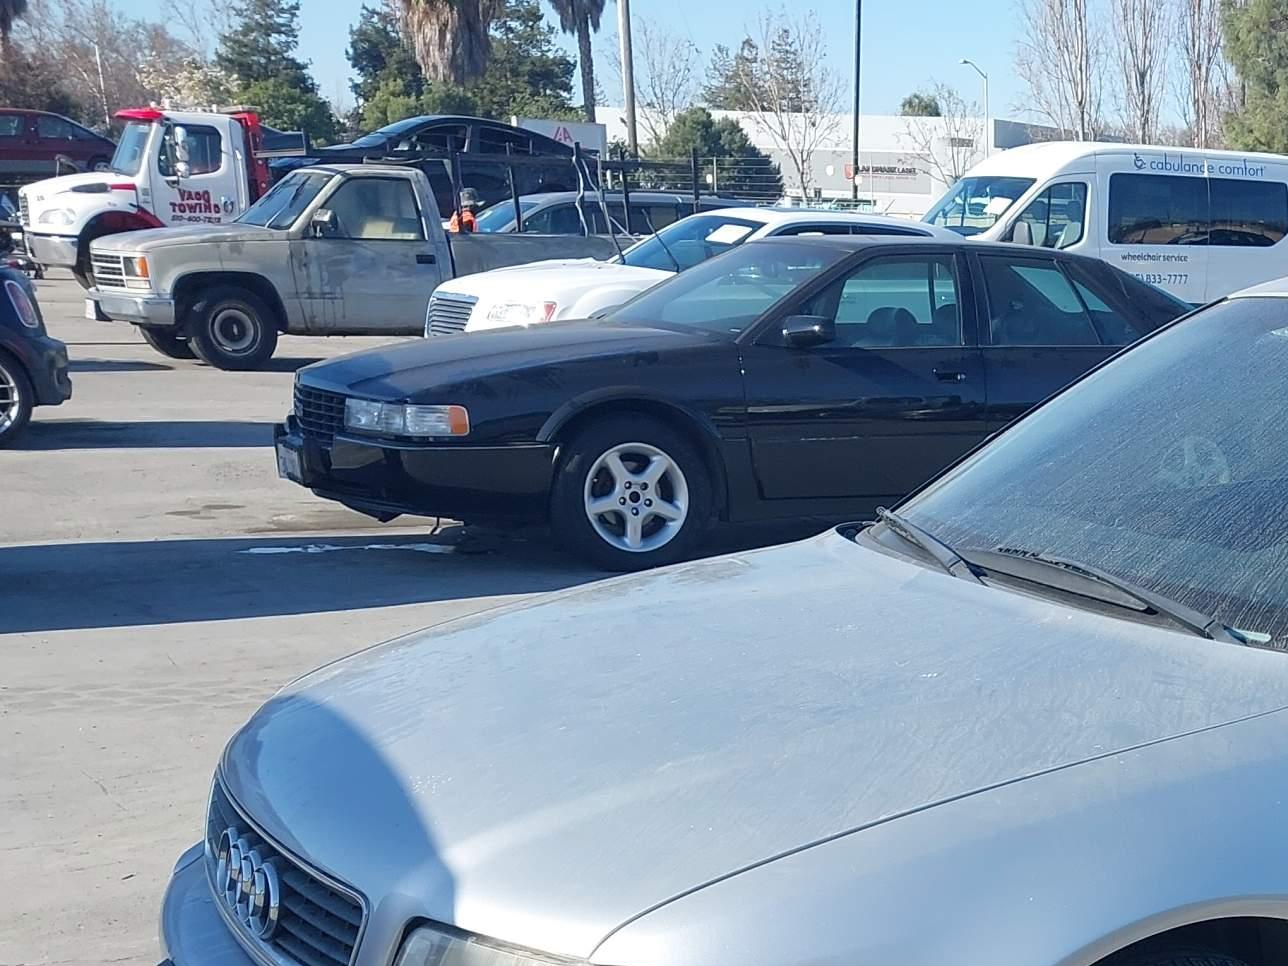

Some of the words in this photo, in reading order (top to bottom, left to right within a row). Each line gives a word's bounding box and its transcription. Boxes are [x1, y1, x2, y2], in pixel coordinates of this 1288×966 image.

[1150, 153, 1214, 174] cabulance
[1218, 159, 1264, 177] comfort
[169, 202, 221, 214] TOWING
[1121, 252, 1162, 261] wheelchair
[1163, 253, 1188, 262] service
